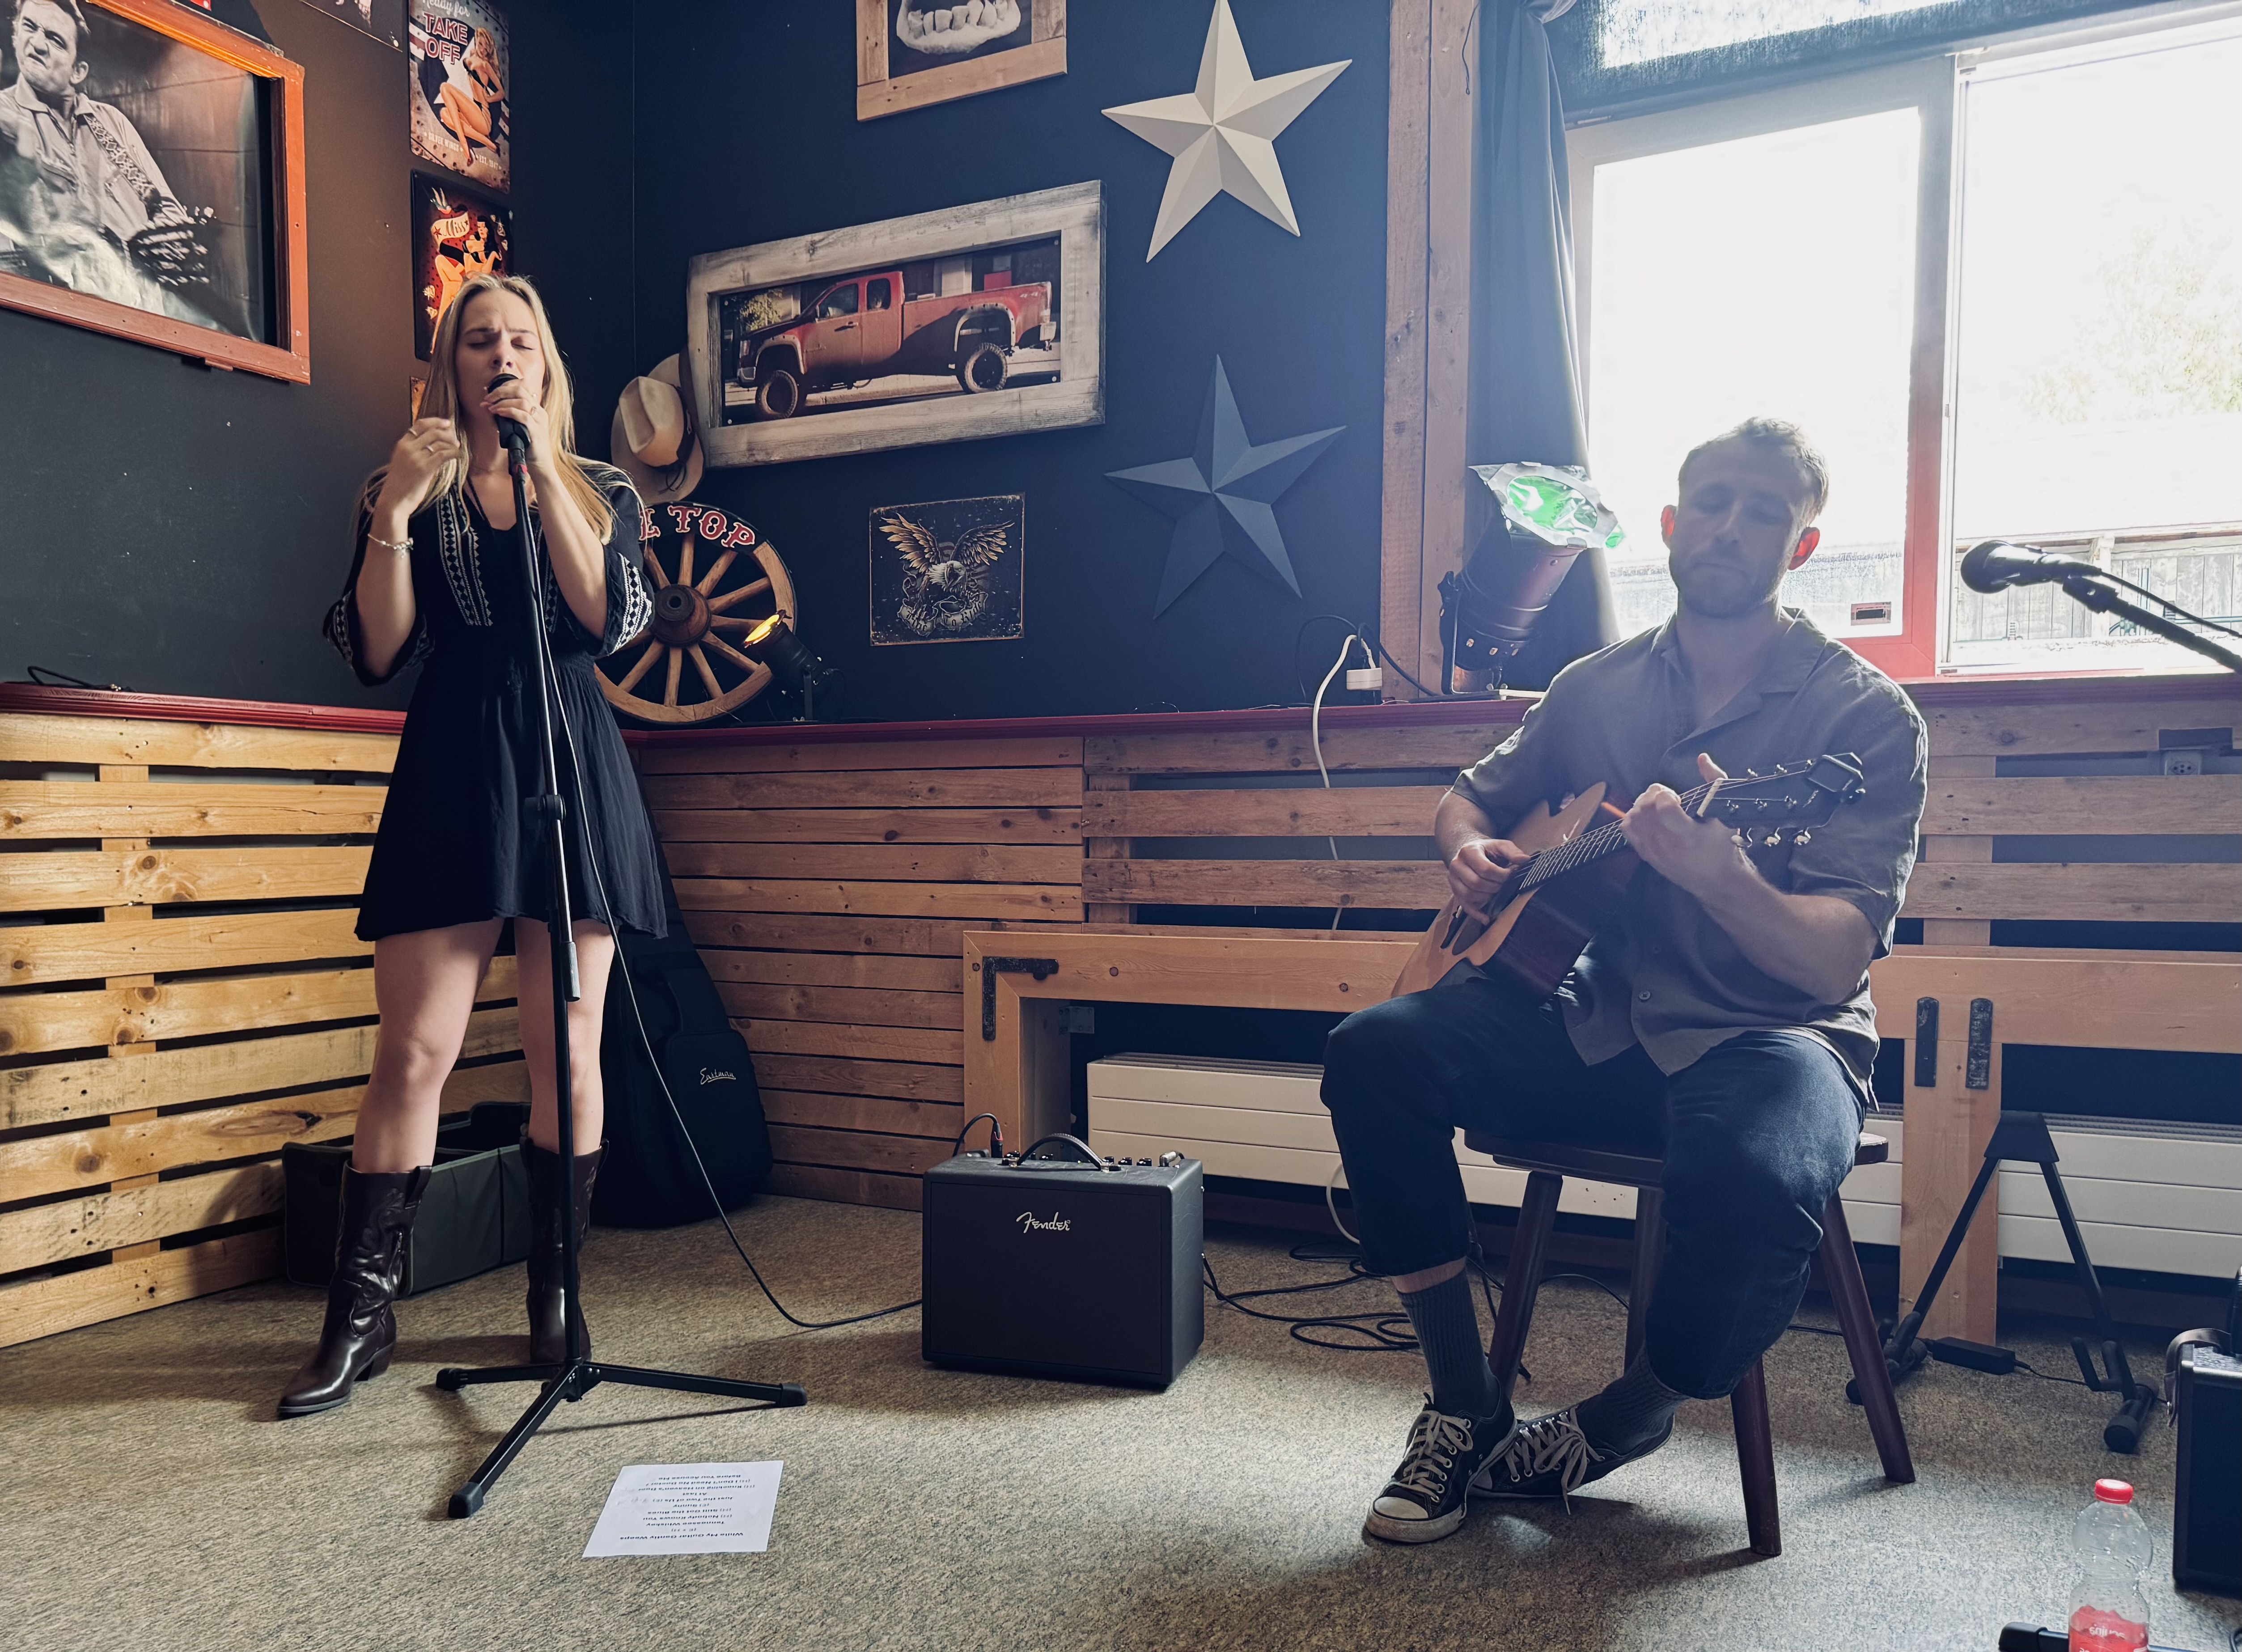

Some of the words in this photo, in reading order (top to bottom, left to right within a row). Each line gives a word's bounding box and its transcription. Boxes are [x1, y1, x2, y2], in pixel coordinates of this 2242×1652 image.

[453, 1, 470, 17] for
[422, 11, 468, 46] TAKE
[425, 37, 460, 64] OFF
[428, 132, 443, 144] SILVER
[445, 140, 459, 152] WINGS
[443, 220, 466, 236] Miss
[667, 505, 755, 548] TOP
[700, 1067, 736, 1085] Eastman
[1016, 1211, 1070, 1233] Fender
